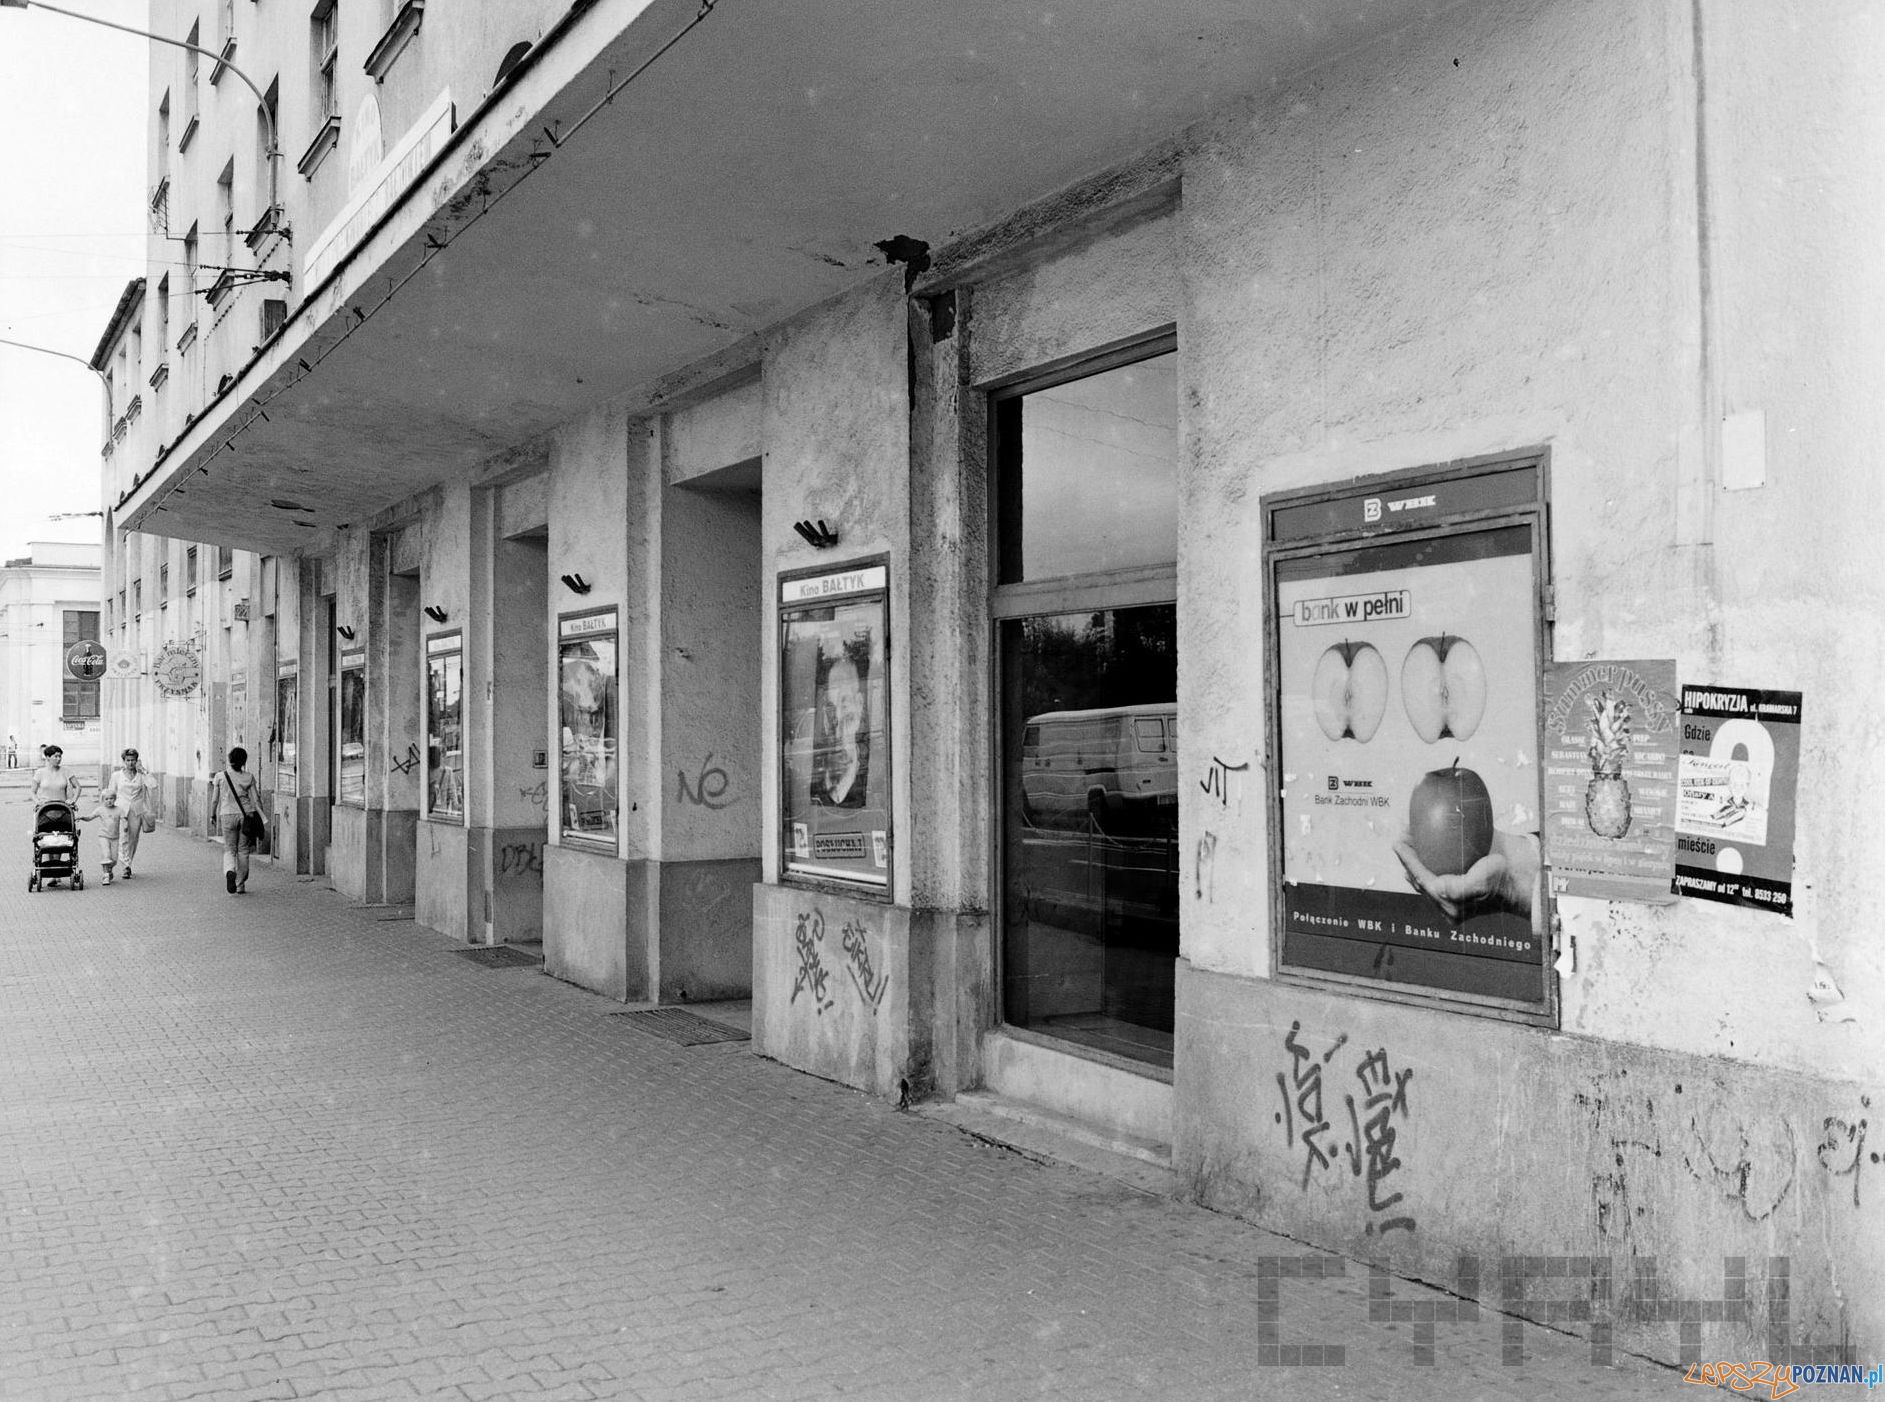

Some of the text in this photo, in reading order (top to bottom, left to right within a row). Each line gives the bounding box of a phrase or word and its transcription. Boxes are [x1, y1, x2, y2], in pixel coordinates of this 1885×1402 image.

[822, 574, 864, 593] BAŁTYK
[1302, 591, 1403, 621] bank w pełni
[1684, 691, 1748, 712] HIPOKRYZJA
[1684, 724, 1711, 740] Gdzie
[1314, 794, 1391, 807] Bank Zachodni WBK
[1678, 836, 1716, 855] mieście
[1675, 875, 1717, 892] ZAPRASZAMY
[1717, 883, 1726, 893] od
[1293, 911, 1349, 927] Połączenie
[1358, 919, 1382, 931] WBK
[1405, 925, 1440, 939] Banku
[1451, 931, 1531, 951] Zachodniego
